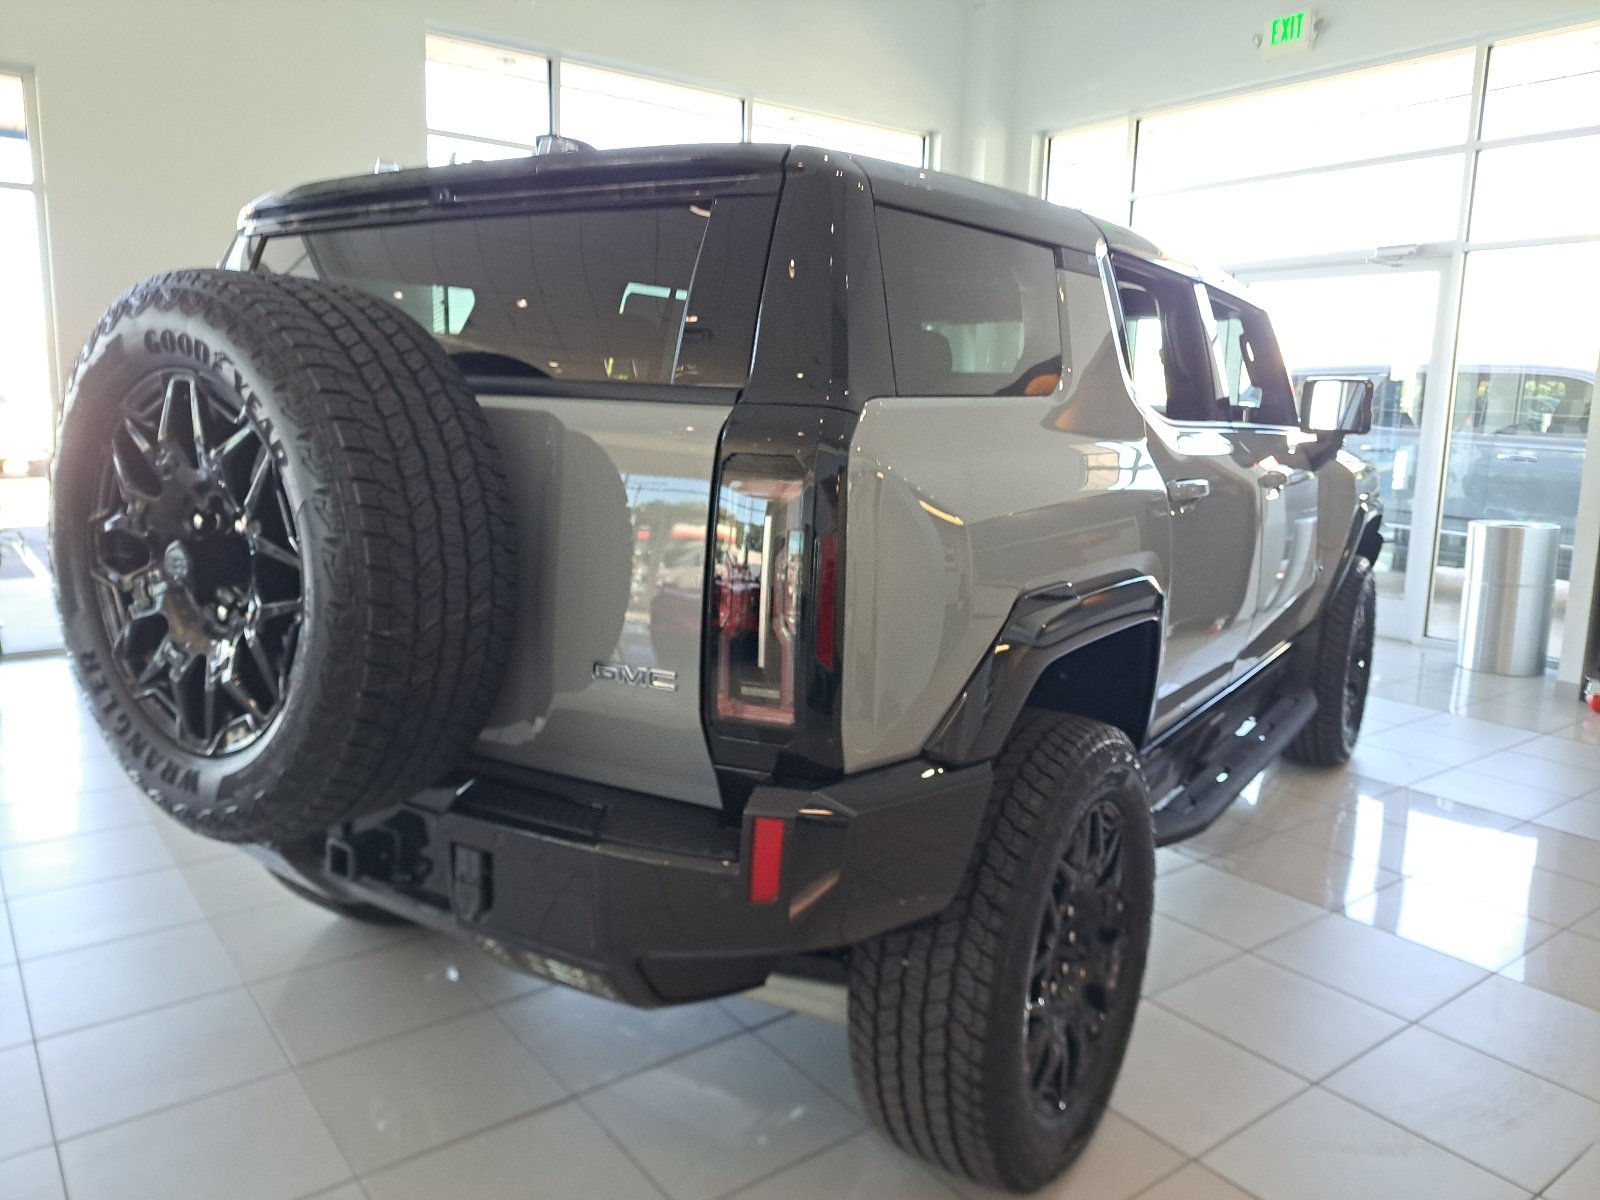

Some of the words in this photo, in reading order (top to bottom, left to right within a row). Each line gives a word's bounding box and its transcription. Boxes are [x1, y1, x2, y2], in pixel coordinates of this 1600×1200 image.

[1271, 12, 1305, 46] EXIT
[143, 328, 289, 469] GOODYEAR
[592, 662, 679, 693] GMC
[79, 651, 201, 794] WRANGLER
